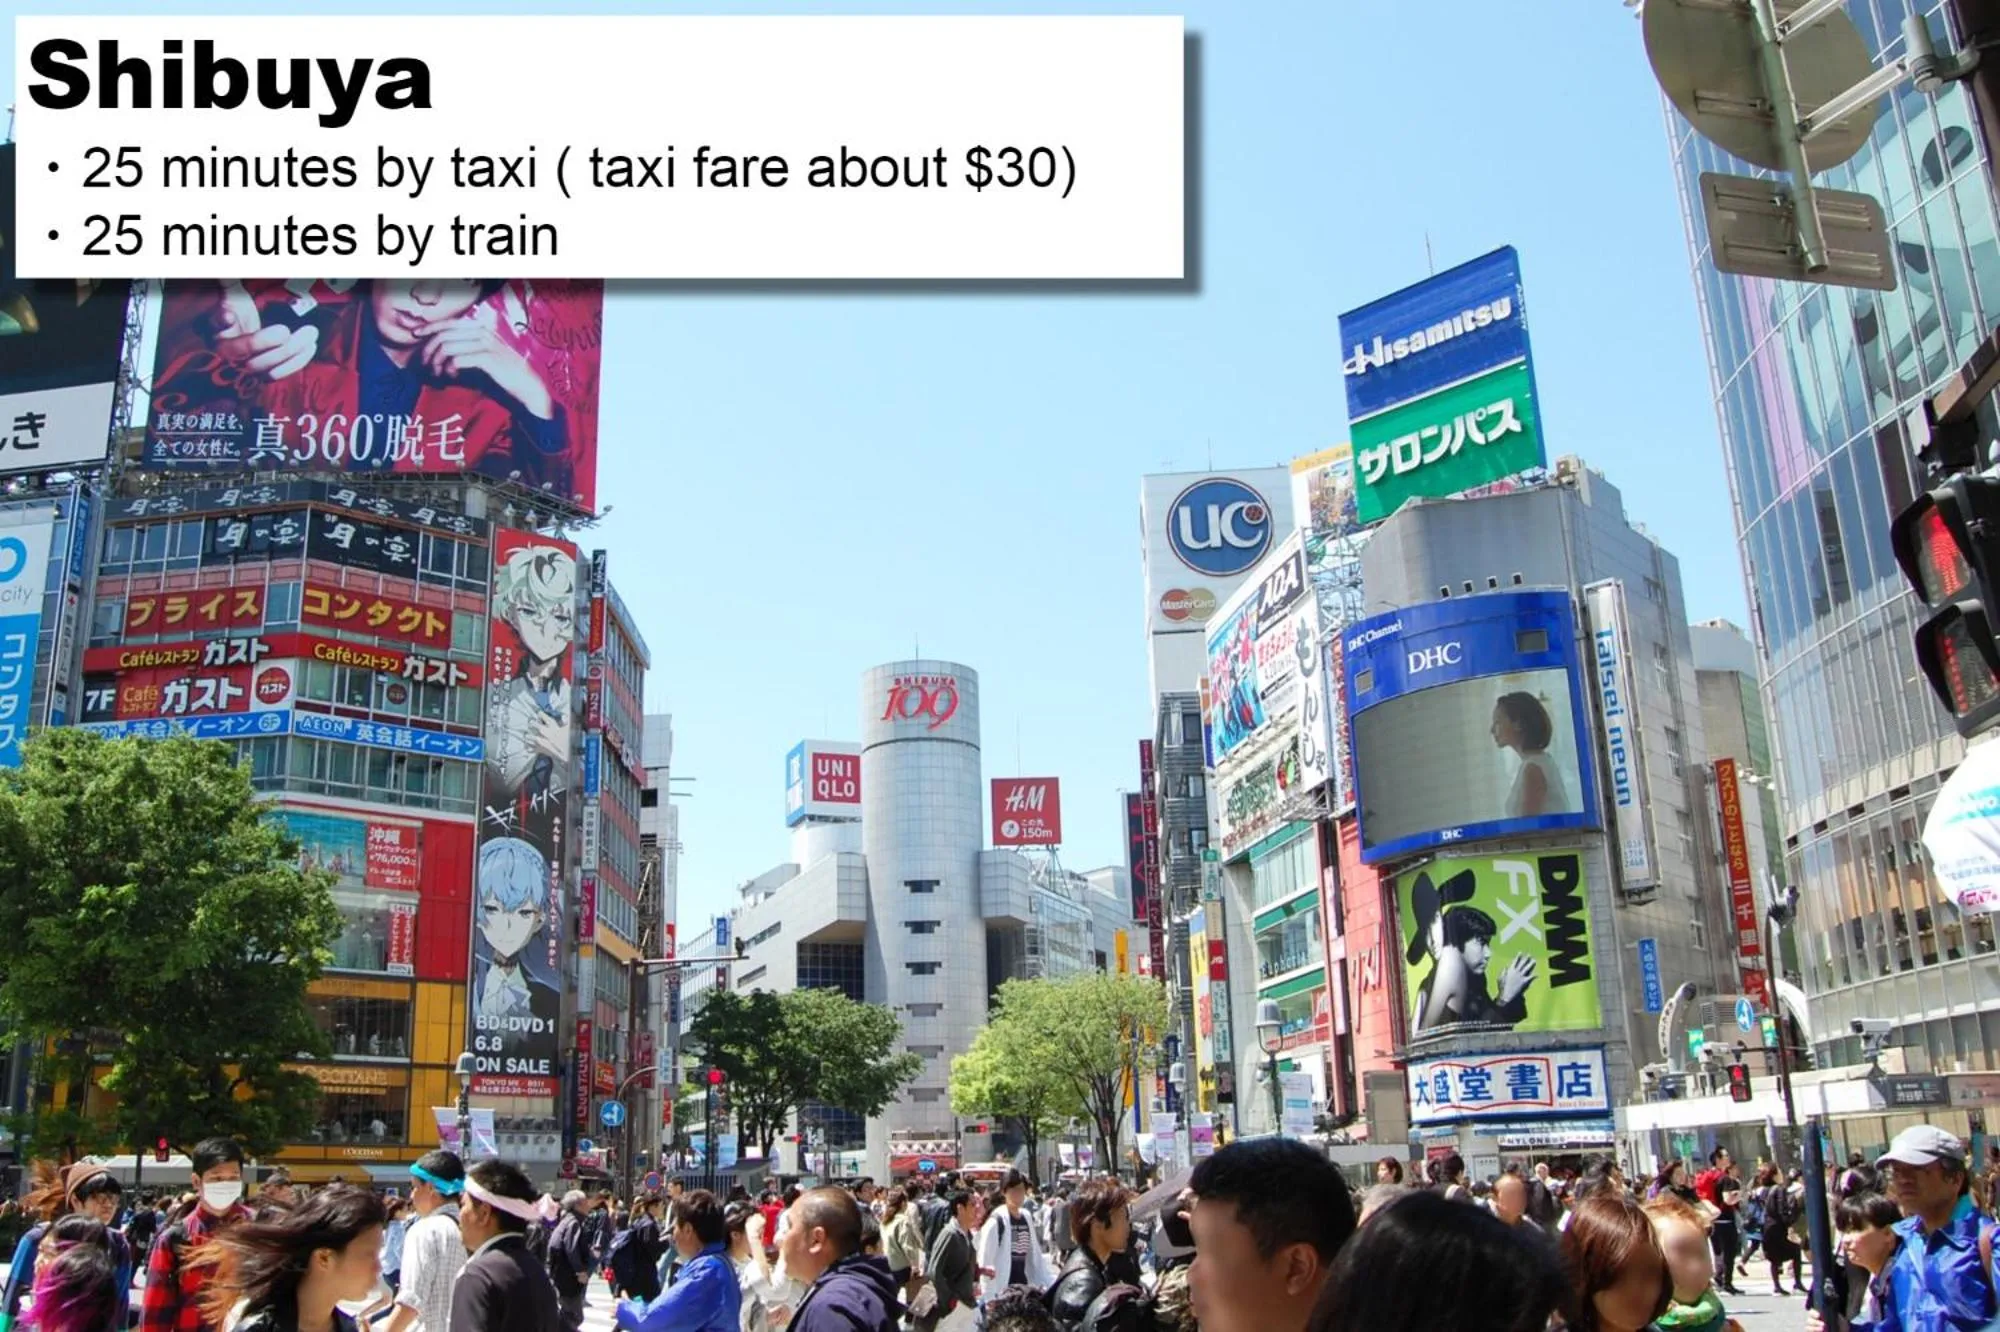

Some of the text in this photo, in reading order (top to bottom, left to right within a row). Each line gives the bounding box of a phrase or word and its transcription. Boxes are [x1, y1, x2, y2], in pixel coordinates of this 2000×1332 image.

[1342, 296, 1513, 375] Hisamitsu
[0, 411, 46, 451] き
[157, 412, 243, 431] 真実の満足を、
[153, 439, 241, 457] 全ての女性に。
[1357, 398, 1522, 484] サロンパス
[130, 590, 260, 628] プライス
[303, 588, 446, 637] コンタクト
[203, 637, 270, 666] ガスト
[1348, 618, 1403, 653] DHC Channel
[402, 655, 468, 687] ガスト
[1408, 641, 1462, 675] DHC
[160, 677, 243, 714] ガスト
[259, 684, 288, 694] ガスト
[894, 676, 955, 686] SHIBUYA
[85, 688, 116, 711] 7F
[880, 684, 959, 730] 109
[260, 715, 279, 730] 6F
[302, 717, 344, 734] AEON
[356, 723, 481, 755] 英会話イーオン
[817, 758, 853, 777] UNI
[1609, 725, 1634, 806] neon
[817, 779, 856, 799] QLO
[1004, 785, 1046, 812] H&M
[1022, 828, 1053, 838] 150m
[1719, 763, 1746, 871] クスリのことなら
[1733, 879, 1758, 947] 三千里
[1493, 859, 1543, 945] FX
[1538, 854, 1592, 989] DMM
[475, 1035, 503, 1052] 6.8
[475, 1056, 550, 1075] ON SALE
[1414, 1063, 1593, 1108] 大盛堂書店
